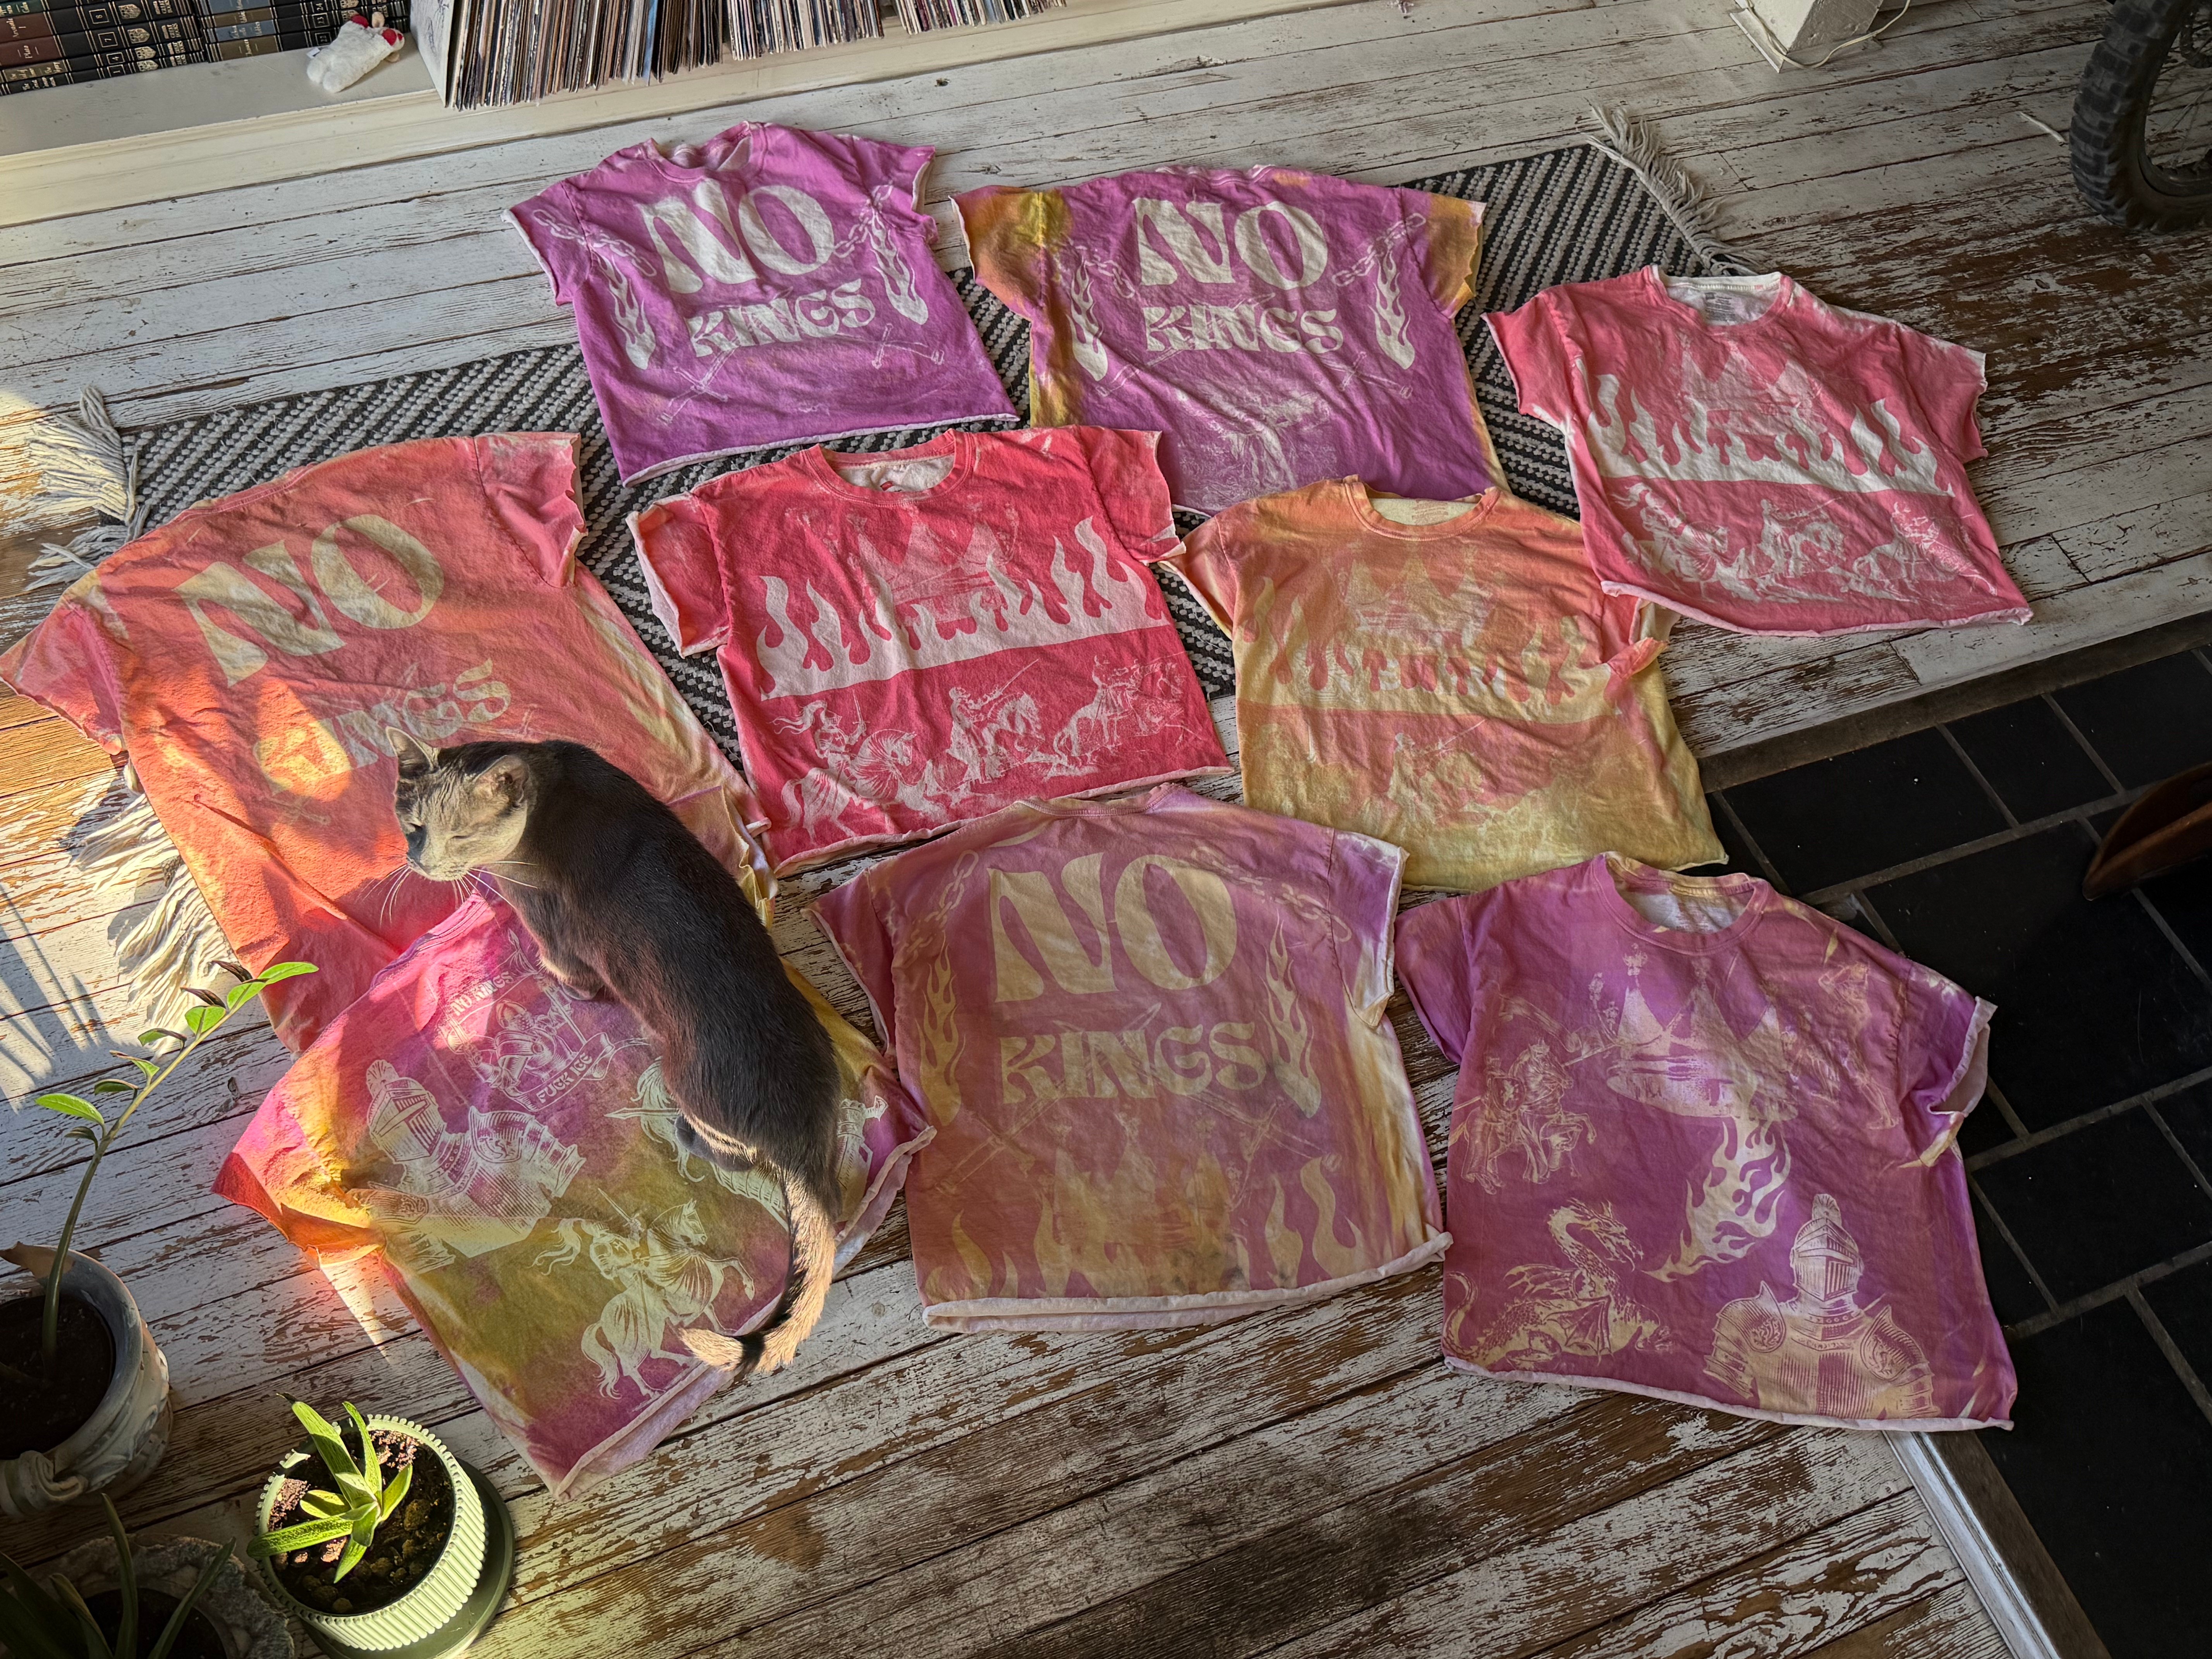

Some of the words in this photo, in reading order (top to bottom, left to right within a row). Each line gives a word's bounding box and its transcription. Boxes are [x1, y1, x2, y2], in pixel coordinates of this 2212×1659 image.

[635, 178, 835, 294] NO
[1132, 197, 1328, 290] NO
[685, 279, 876, 357] KINGS
[1144, 305, 1343, 354] KINGS
[175, 514, 444, 687] NO
[987, 852, 1237, 1002] NO
[451, 994, 472, 1016] NO
[472, 971, 514, 1001] KINGS
[536, 1072, 574, 1103] FUCK
[569, 1053, 592, 1076] ICE
[1000, 1022, 1266, 1104] KINGS
